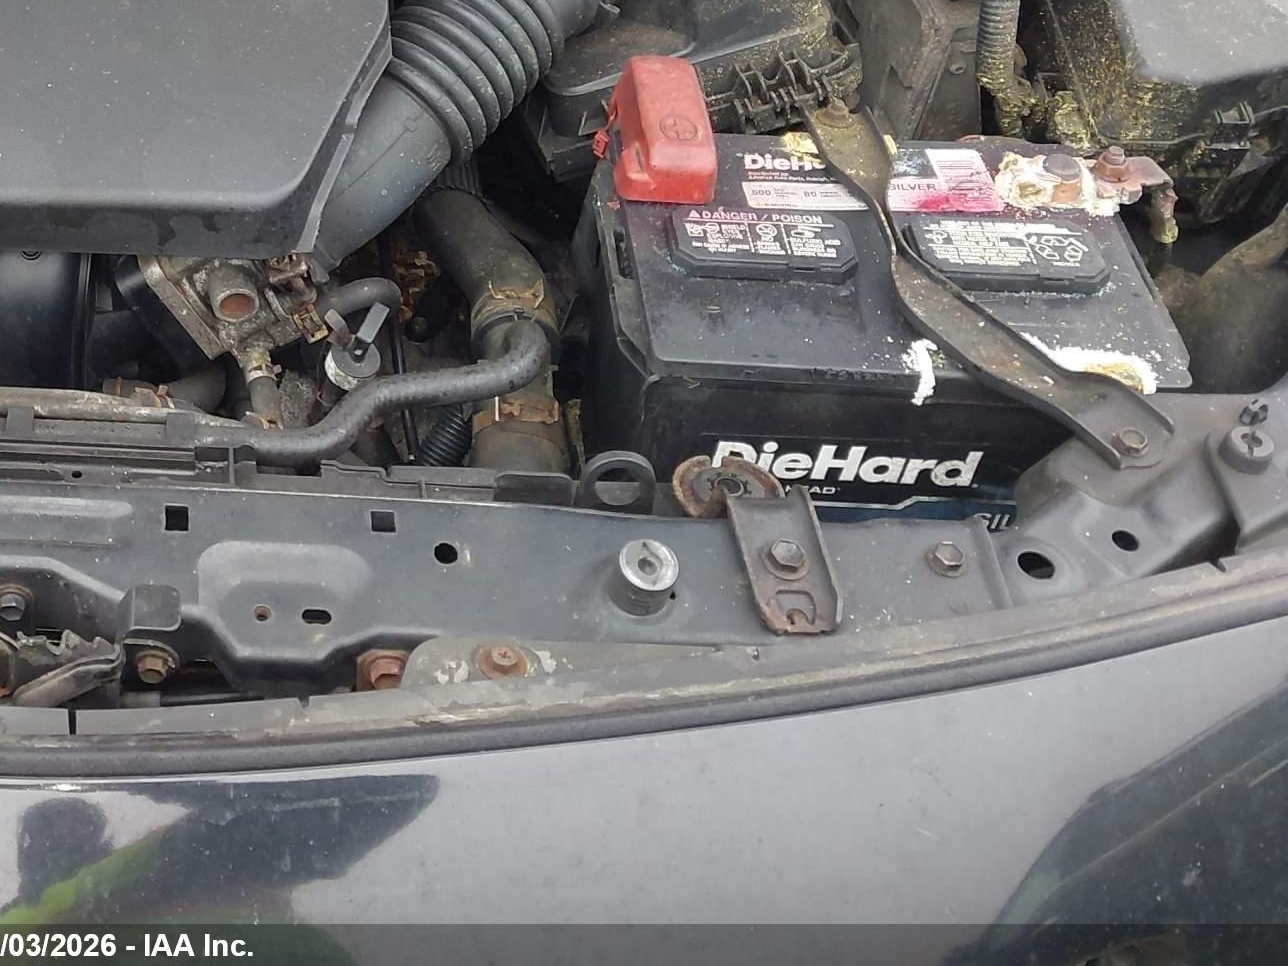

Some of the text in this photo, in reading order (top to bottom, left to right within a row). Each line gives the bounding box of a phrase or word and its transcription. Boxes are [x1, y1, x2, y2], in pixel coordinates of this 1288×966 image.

[889, 183, 937, 191] SILVER
[701, 210, 758, 221] DANGER
[772, 214, 823, 224] POISON
[712, 440, 984, 487] DieHard
